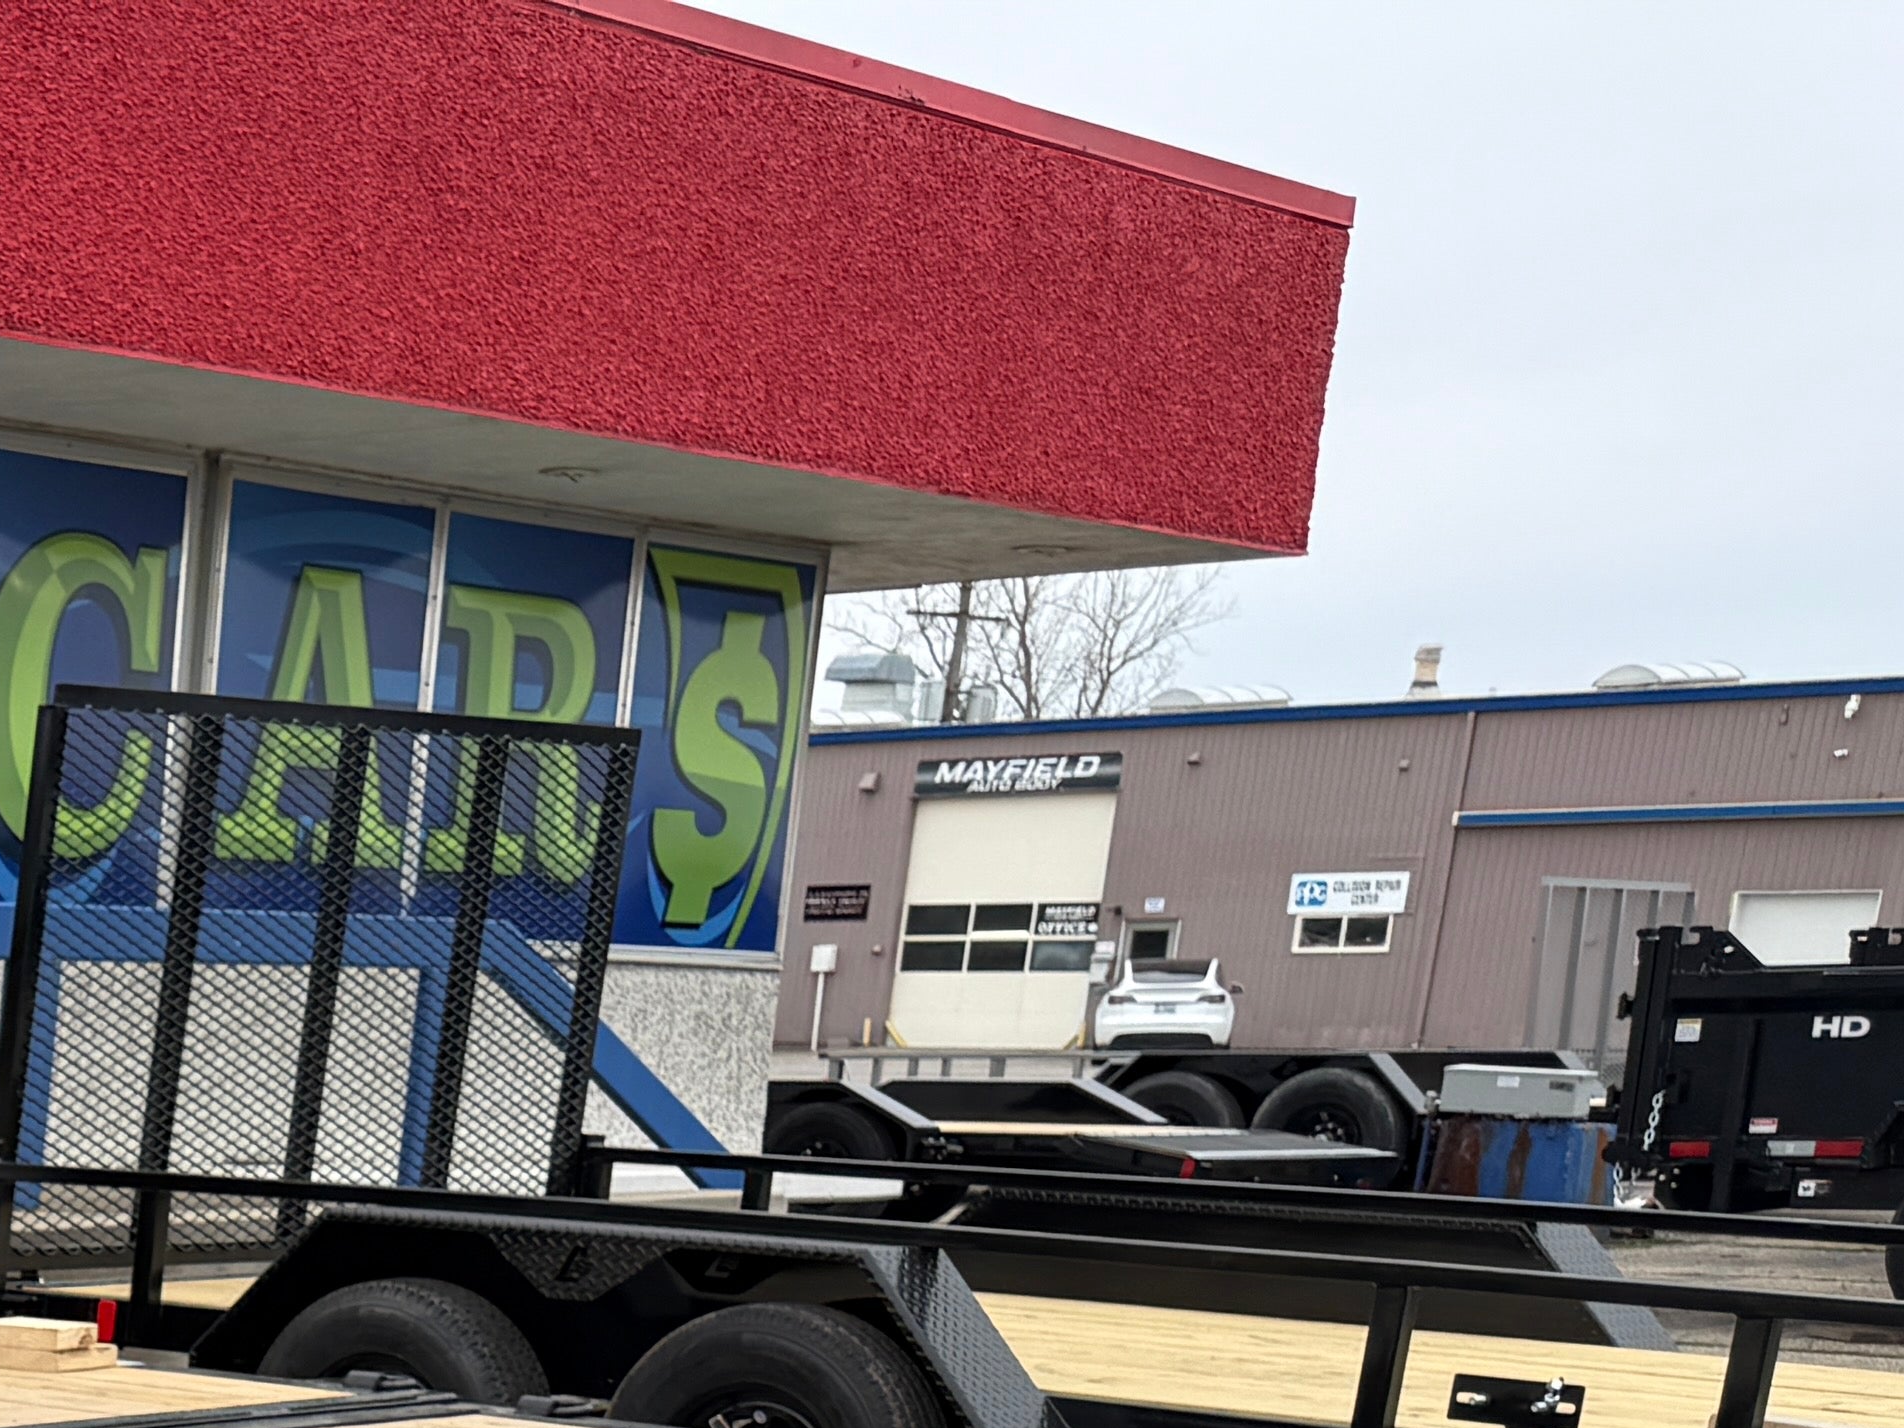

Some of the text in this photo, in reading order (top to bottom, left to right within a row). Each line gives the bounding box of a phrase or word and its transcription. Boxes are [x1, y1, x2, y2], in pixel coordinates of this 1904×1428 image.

[935, 756, 1101, 784] MAYFIELD
[967, 779, 1012, 793] AUTO
[1812, 1015, 1871, 1038] HD
